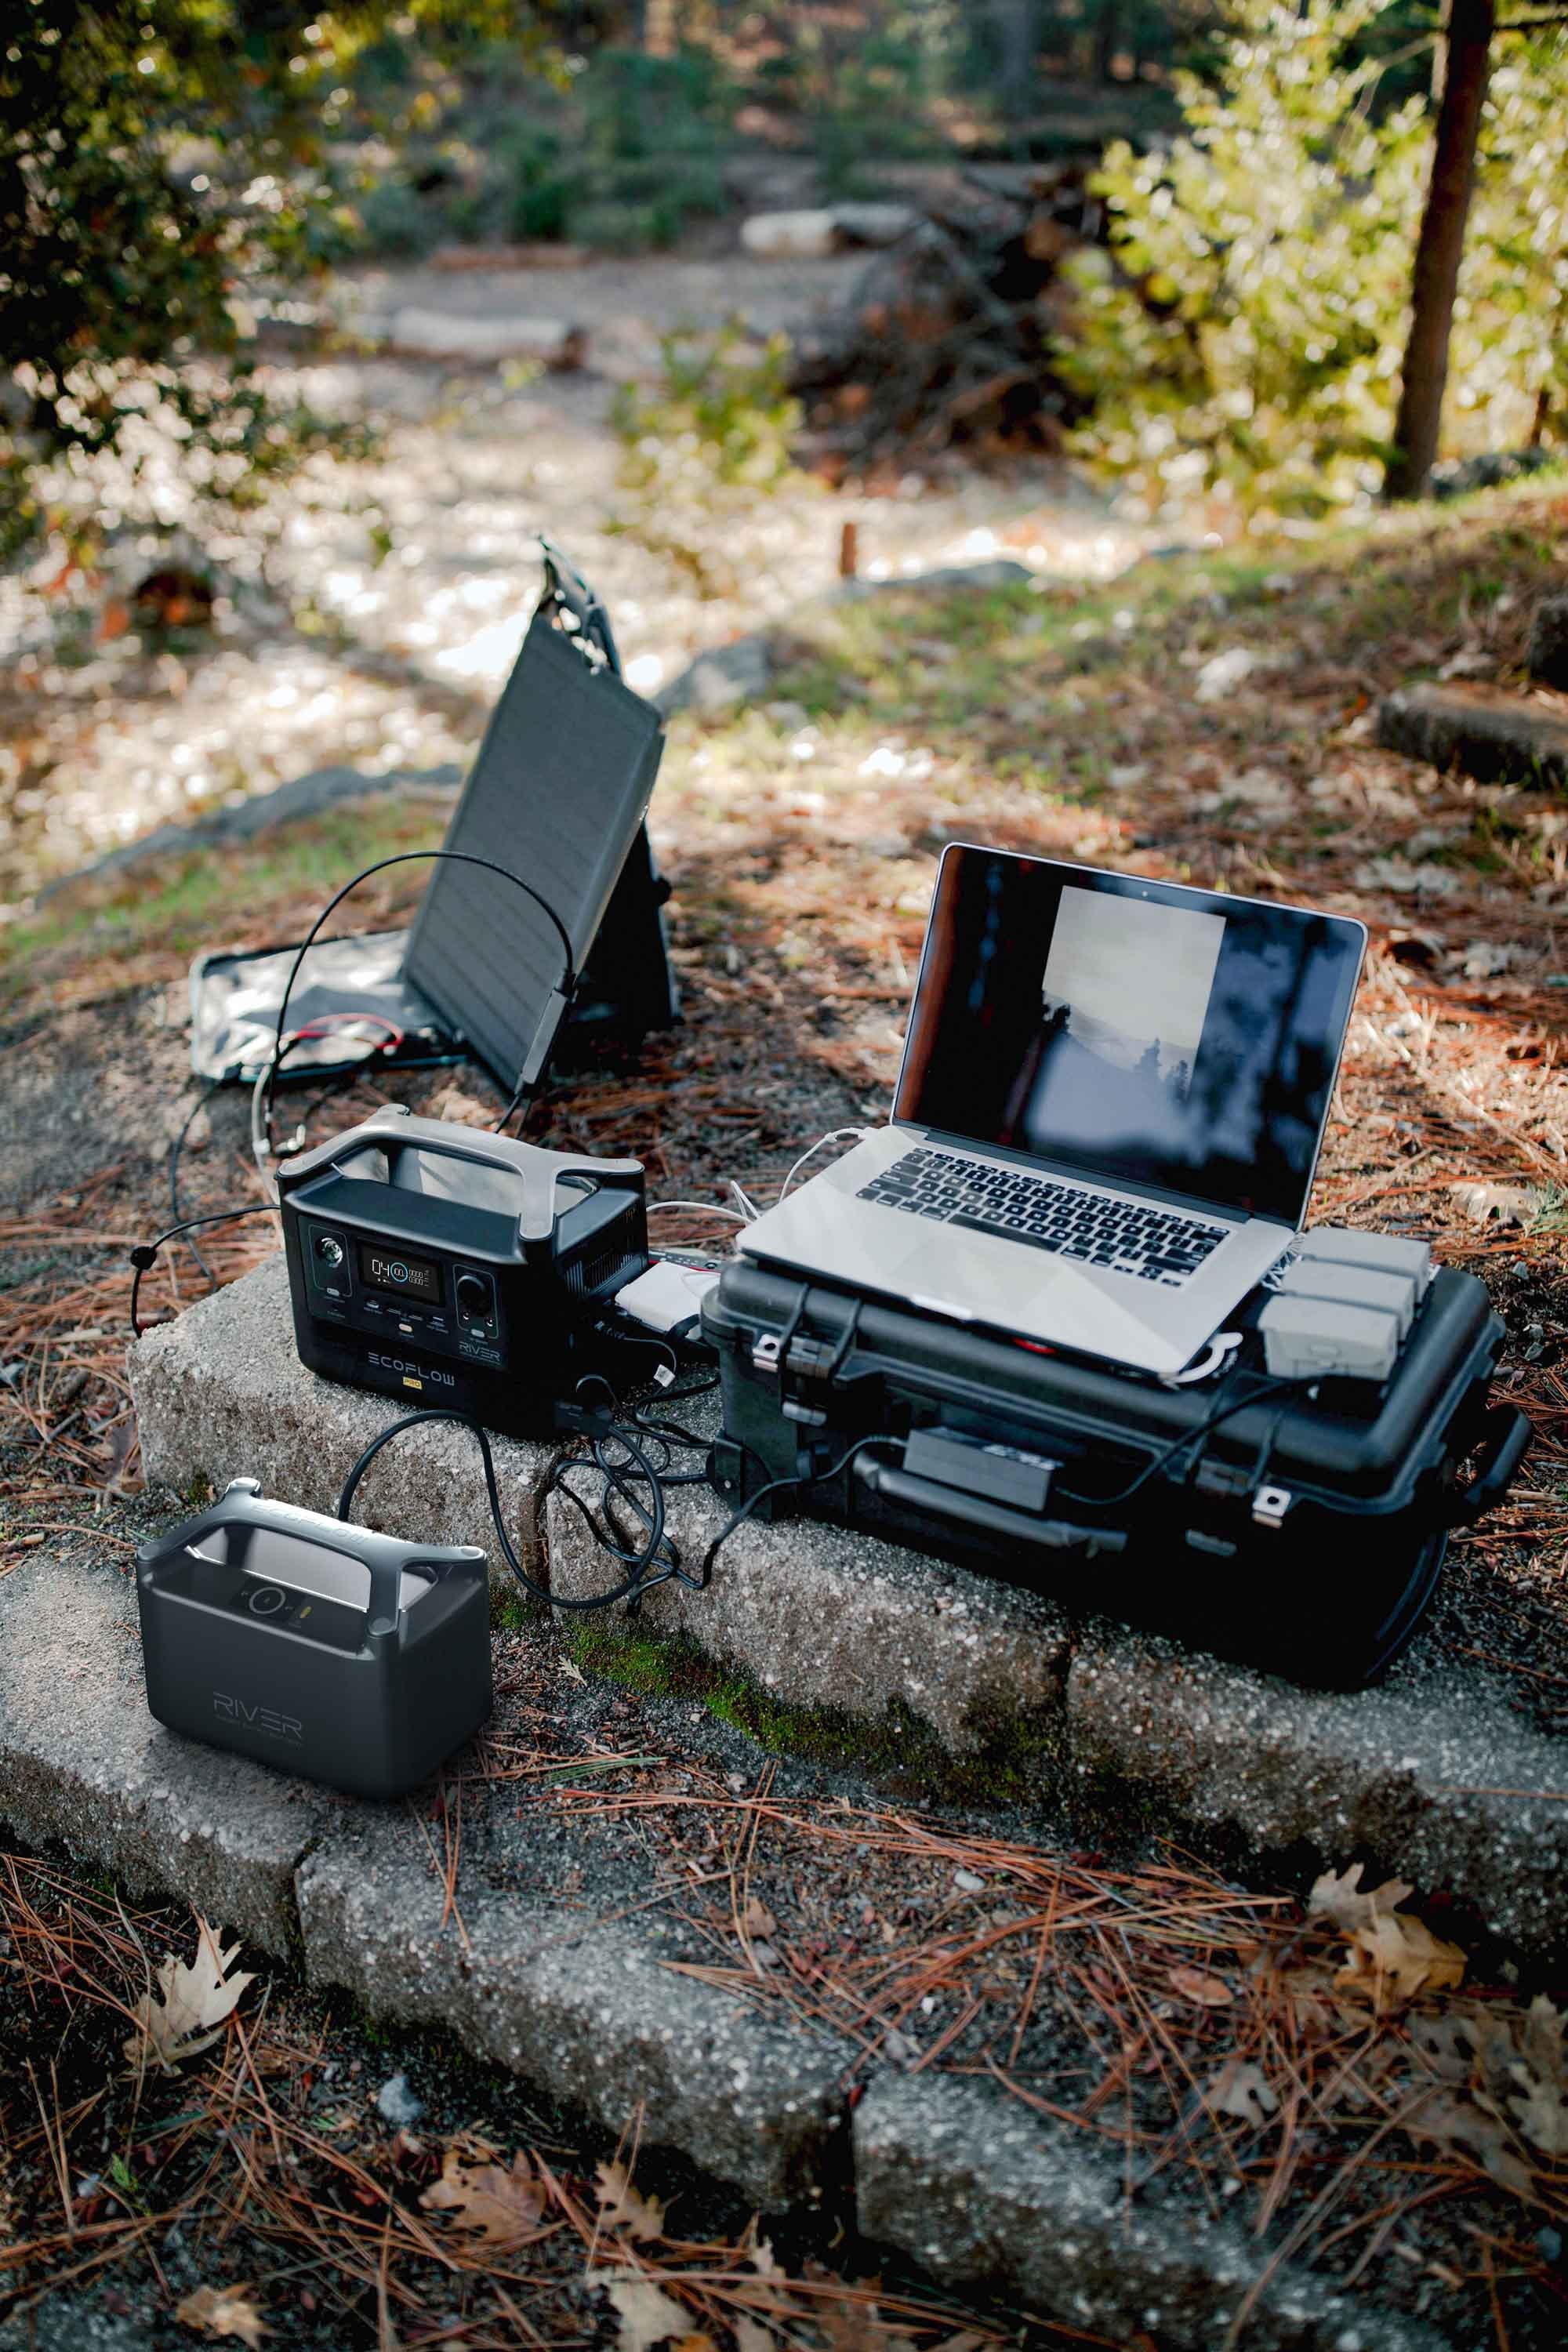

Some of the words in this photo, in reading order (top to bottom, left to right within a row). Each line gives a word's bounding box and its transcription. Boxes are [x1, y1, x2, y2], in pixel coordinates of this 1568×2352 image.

[372, 1259, 390, 1277] 04
[459, 1341, 500, 1362] RIVER
[368, 1352, 455, 1386] ECOFLOW
[404, 1378, 421, 1388] PRO
[212, 1691, 302, 1738] RIVER
